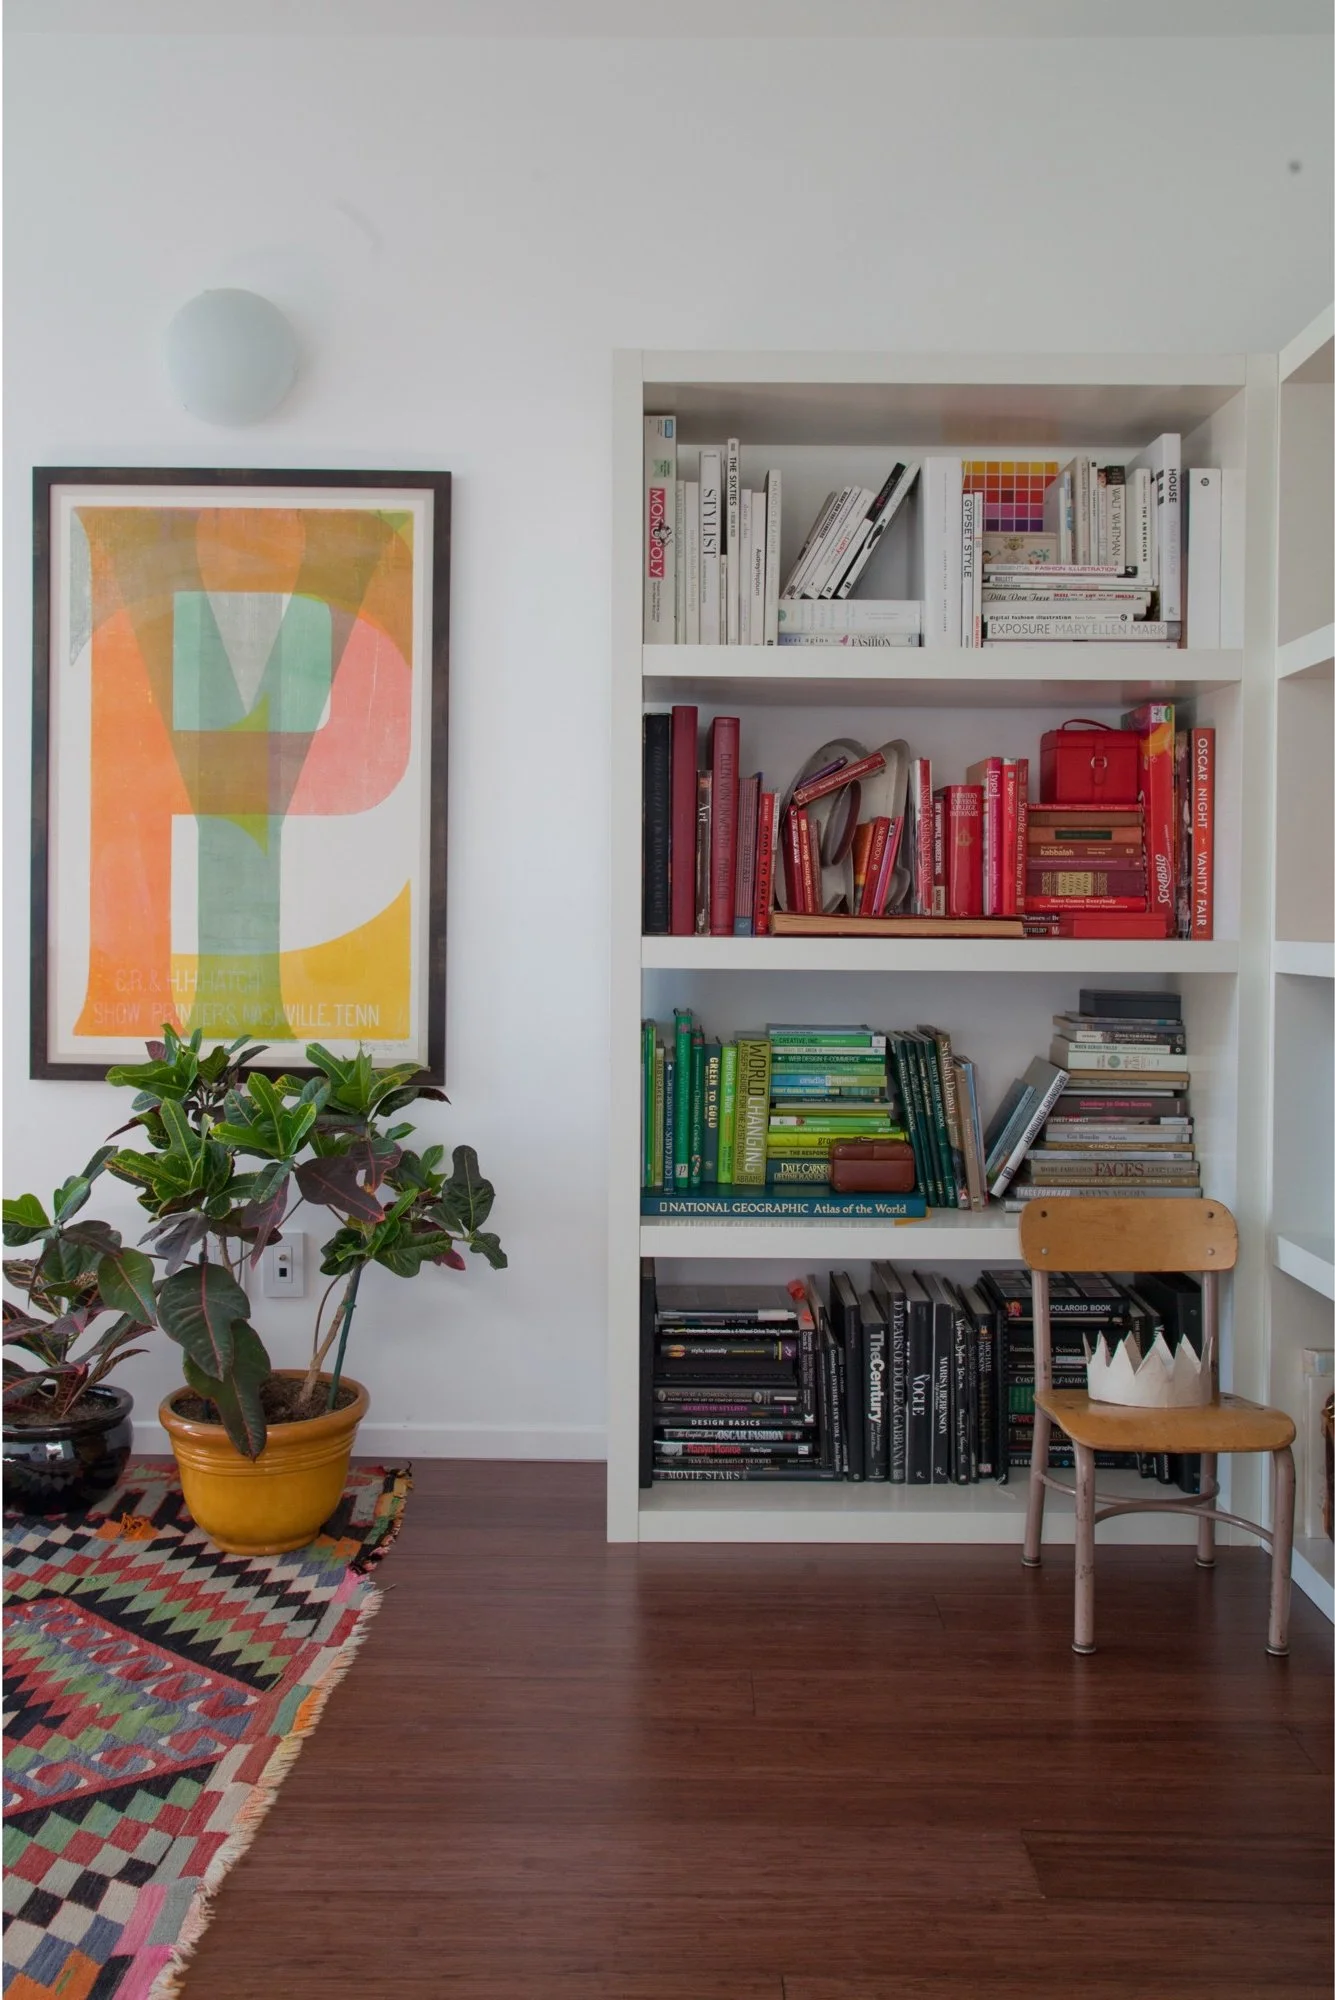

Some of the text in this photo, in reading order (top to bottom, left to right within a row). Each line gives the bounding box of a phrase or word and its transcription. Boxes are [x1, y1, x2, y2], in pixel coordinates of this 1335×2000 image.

[1168, 469, 1177, 504] HOUSE
[650, 489, 664, 577] MONOPOLY
[702, 488, 717, 559] STYLIST
[1111, 487, 1121, 556] WALT WHITMAN
[835, 536, 851, 555] Lucky
[963, 499, 972, 579] GYPSET STYLE
[991, 623, 1166, 635] EXPOSURE MARY ELLEN MARK
[851, 637, 893, 648] FASHION
[720, 753, 732, 779] ELLEN
[719, 783, 731, 801] VON
[921, 784, 932, 885] INSIDE FASHION DESIGN
[1196, 737, 1208, 928] OSCAR NIGHT VANITY FAIR
[1015, 801, 1027, 896] Smoke Gets Your Eyes
[1040, 849, 1075, 857] kabbalah
[756, 825, 769, 917] GOOD TO GREAT
[1154, 853, 1172, 906] SCRABBLE
[93, 1002, 141, 1025] SHOW
[707, 1057, 719, 1129] GREEN TO GOLD
[740, 1073, 748, 1095] GUIDE
[930, 1055, 946, 1130] TRINITY HIGH SCHOOL
[744, 1042, 768, 1174] WORLDCHANGING
[946, 1082, 957, 1115] Drawn
[692, 1125, 700, 1151] Cookies
[1023, 1110, 1048, 1145] STATIONERY
[737, 1175, 763, 1184] ABRAMS
[781, 1162, 802, 1173] DALE
[1094, 1162, 1145, 1177] FACES
[668, 1202, 907, 1215] NATIONAL GEOGRAPHIC Atlas of the World
[1049, 1303, 1112, 1312] POLAROID BOOK
[705, 1347, 728, 1355] naturally
[978, 1340, 986, 1373] JACKSON
[1055, 1346, 1081, 1354] Scissors
[831, 1376, 839, 1405] INVISIBLE
[892, 1312, 905, 1467] YEARS OF DOLCE & GABBANA
[911, 1373, 931, 1417] VOGUE
[938, 1356, 949, 1435] MARISA BERENSON
[691, 1419, 761, 1427] DESIGN BASICS
[832, 1407, 840, 1420] NEW
[717, 1430, 784, 1441] OSCAR FASHION
[688, 1443, 715, 1455] Marilyn
[715, 1443, 742, 1455] Monroe
[669, 1471, 741, 1480] MOVIE STARS
